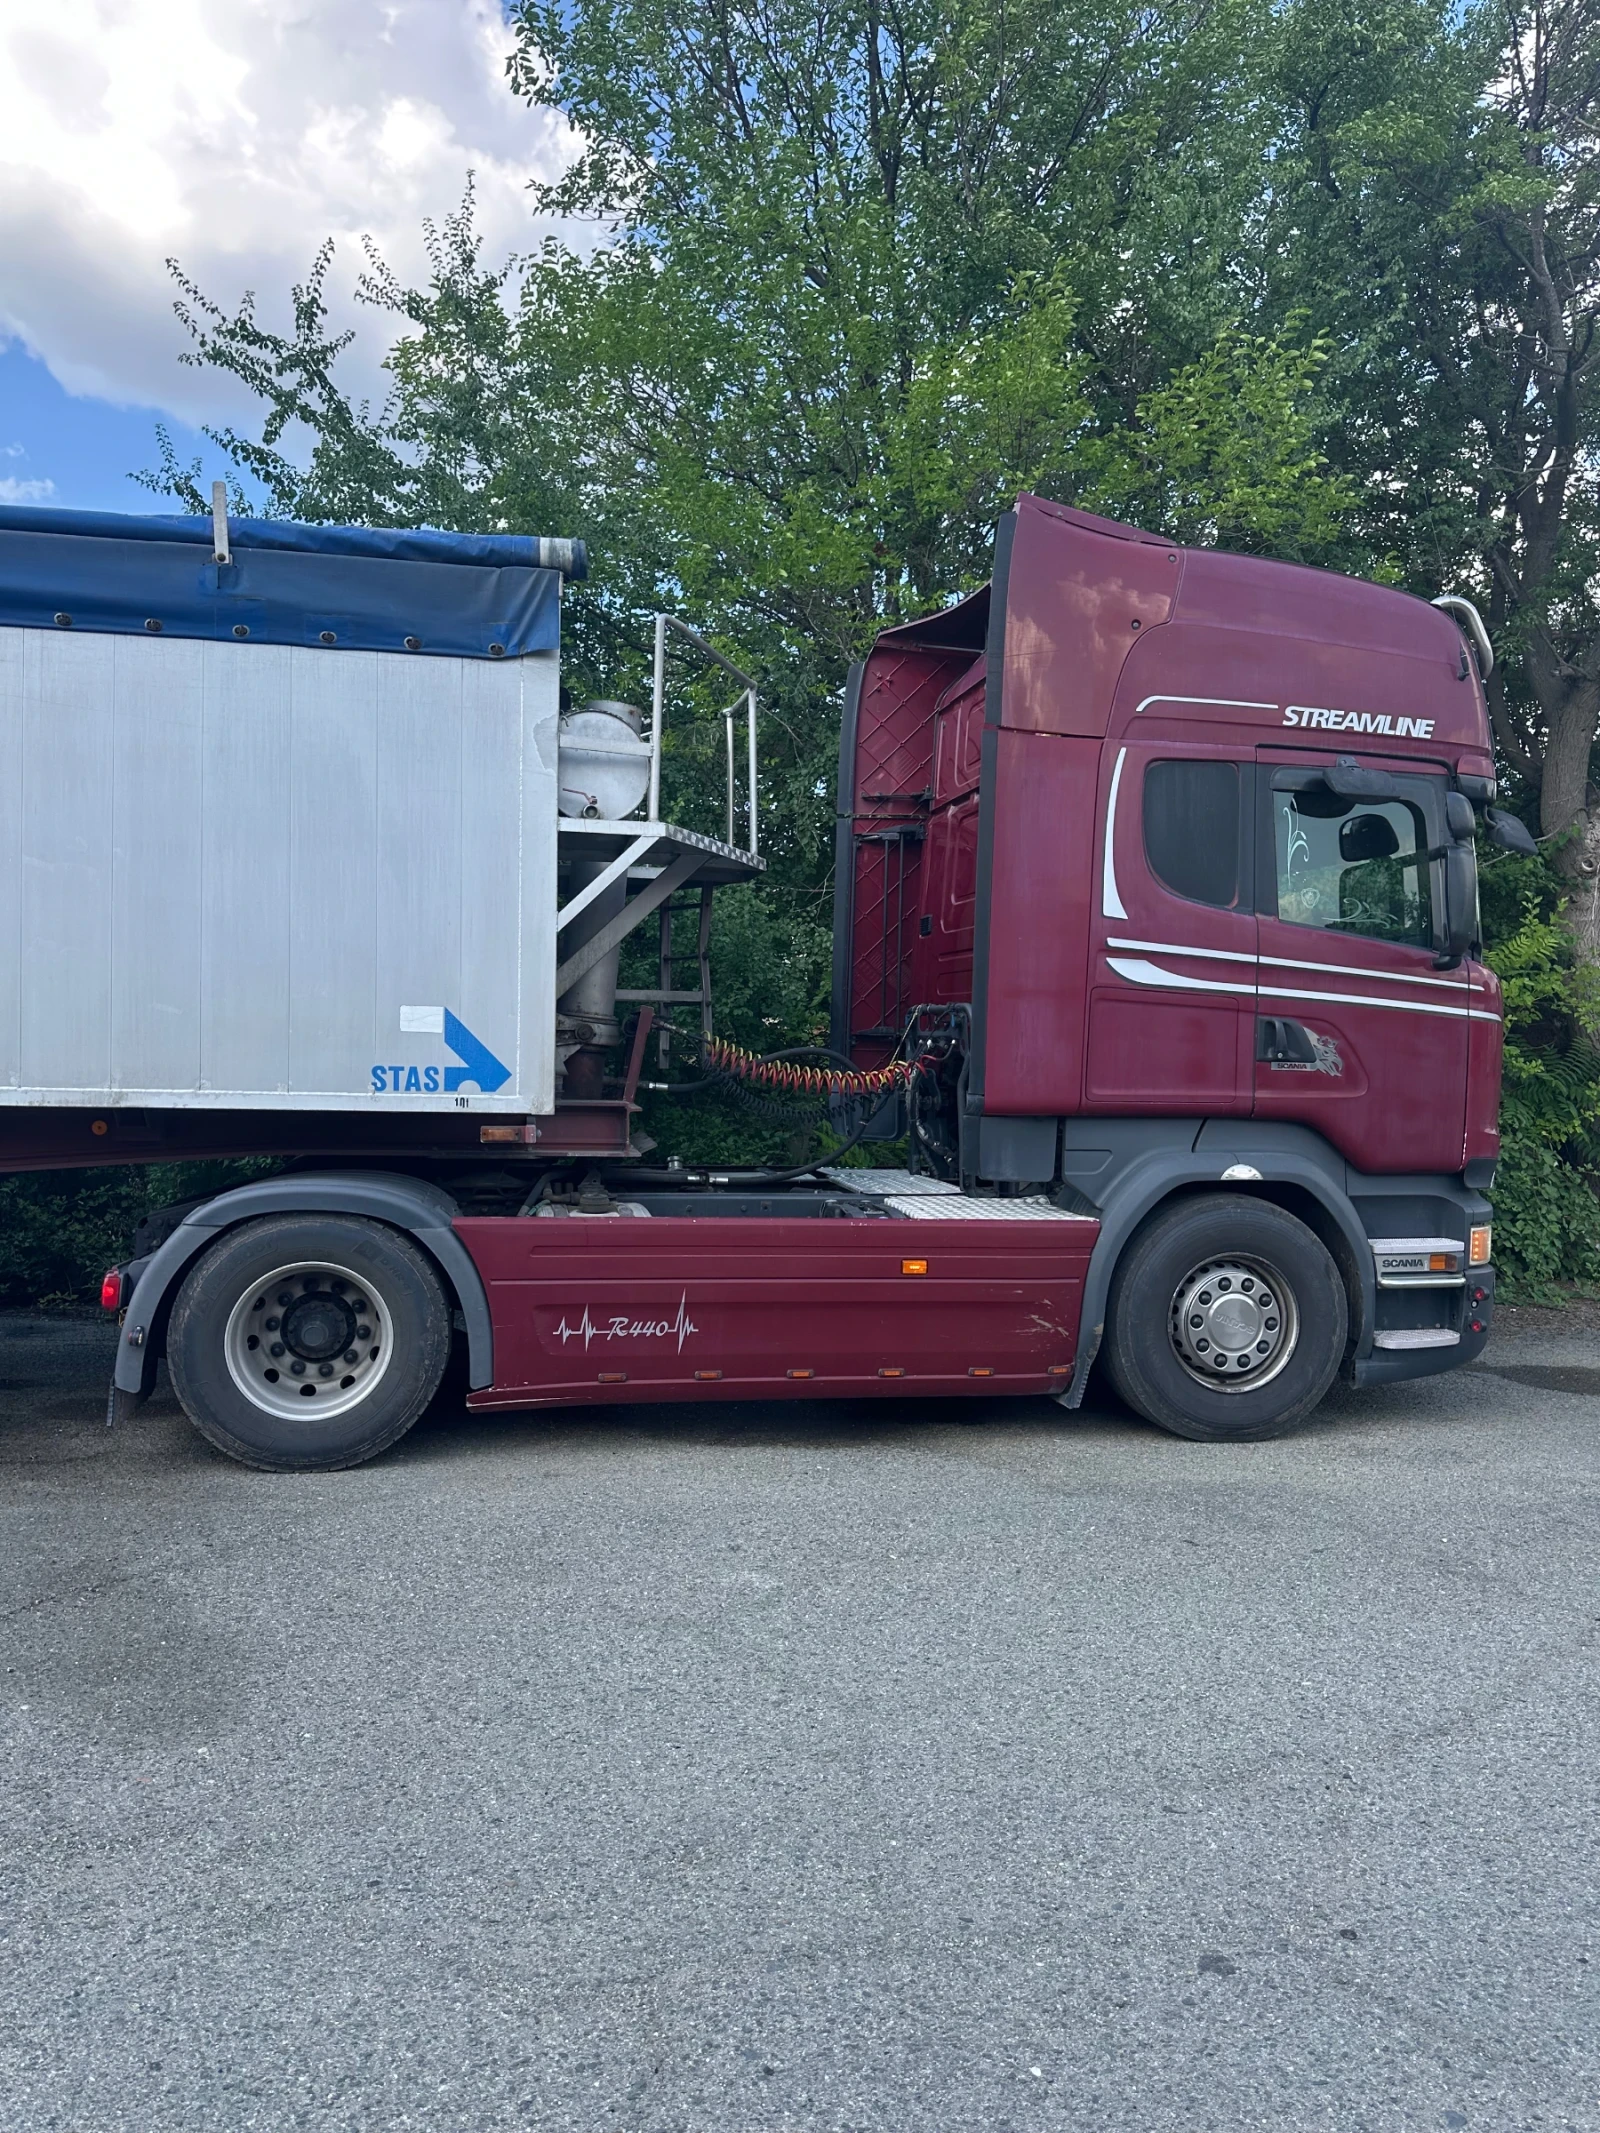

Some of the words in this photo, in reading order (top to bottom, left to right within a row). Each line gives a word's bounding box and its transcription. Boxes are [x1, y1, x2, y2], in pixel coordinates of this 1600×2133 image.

[1282, 705, 1435, 740] STREAMLINE
[371, 1065, 439, 1092] STAS
[1277, 1062, 1307, 1070] SCANIA
[1382, 1259, 1424, 1268] SCANIA
[606, 1316, 669, 1341] R440
